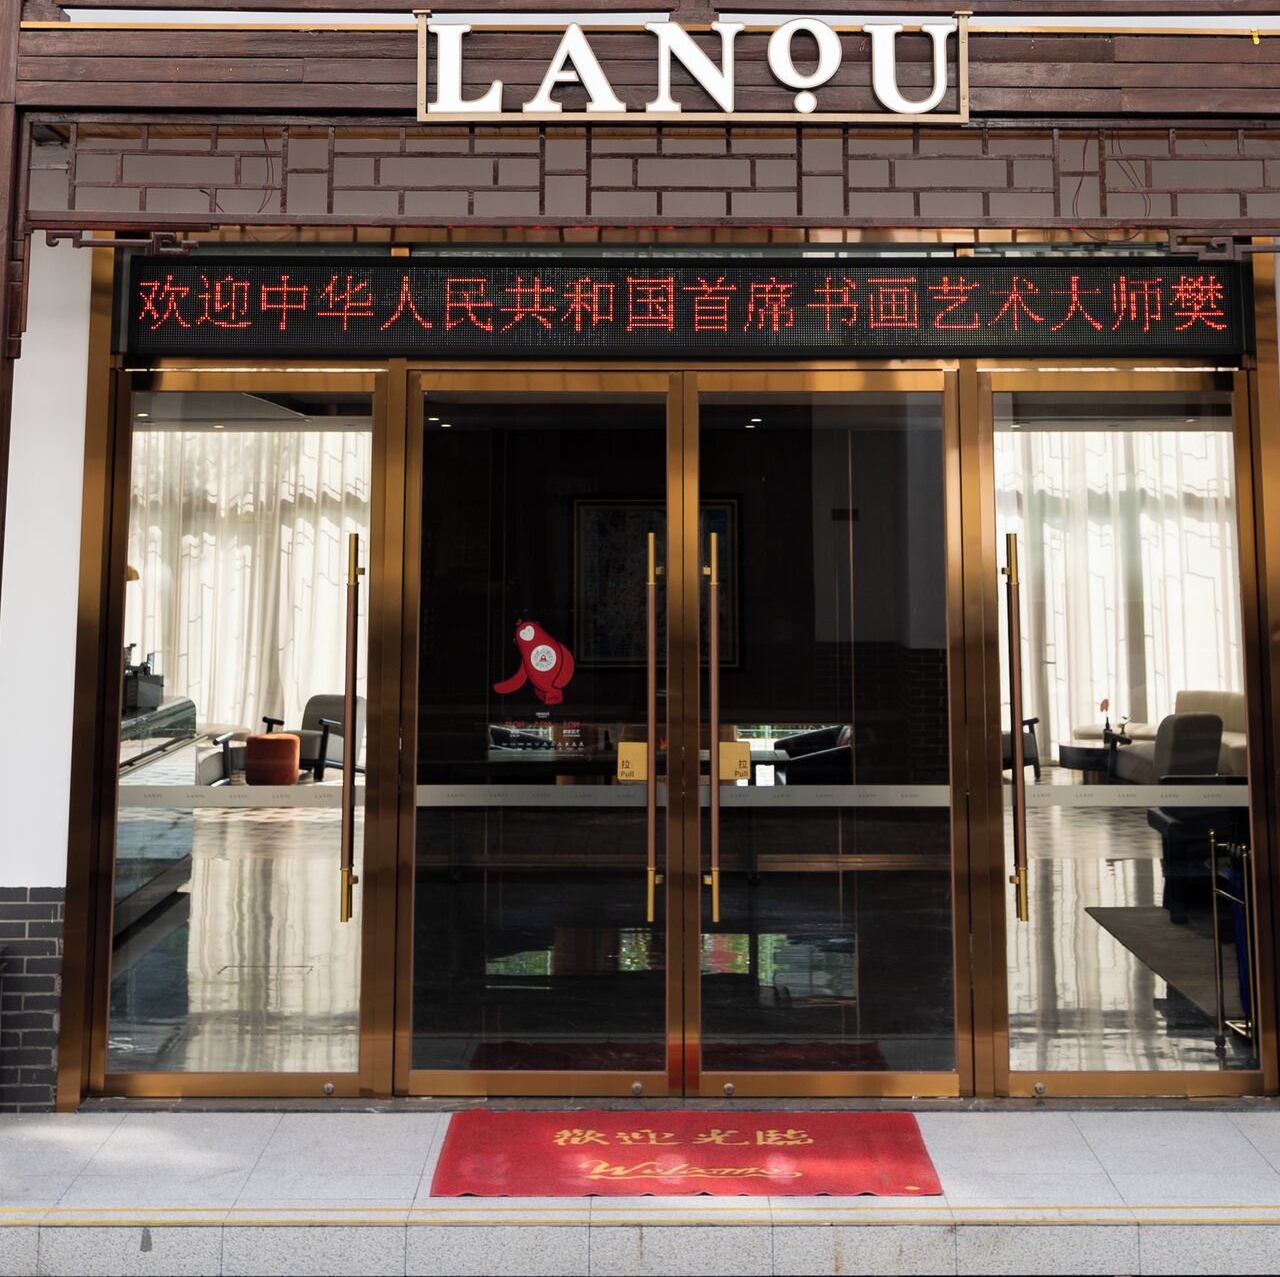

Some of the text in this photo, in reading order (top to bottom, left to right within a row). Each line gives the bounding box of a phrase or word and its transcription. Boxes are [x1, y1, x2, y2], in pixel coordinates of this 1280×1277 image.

[138, 274, 1228, 333] 欢迎中华人民共和国首席书画艺术大师樊
[620, 770, 635, 778] Pull
[734, 770, 749, 778] Pull
